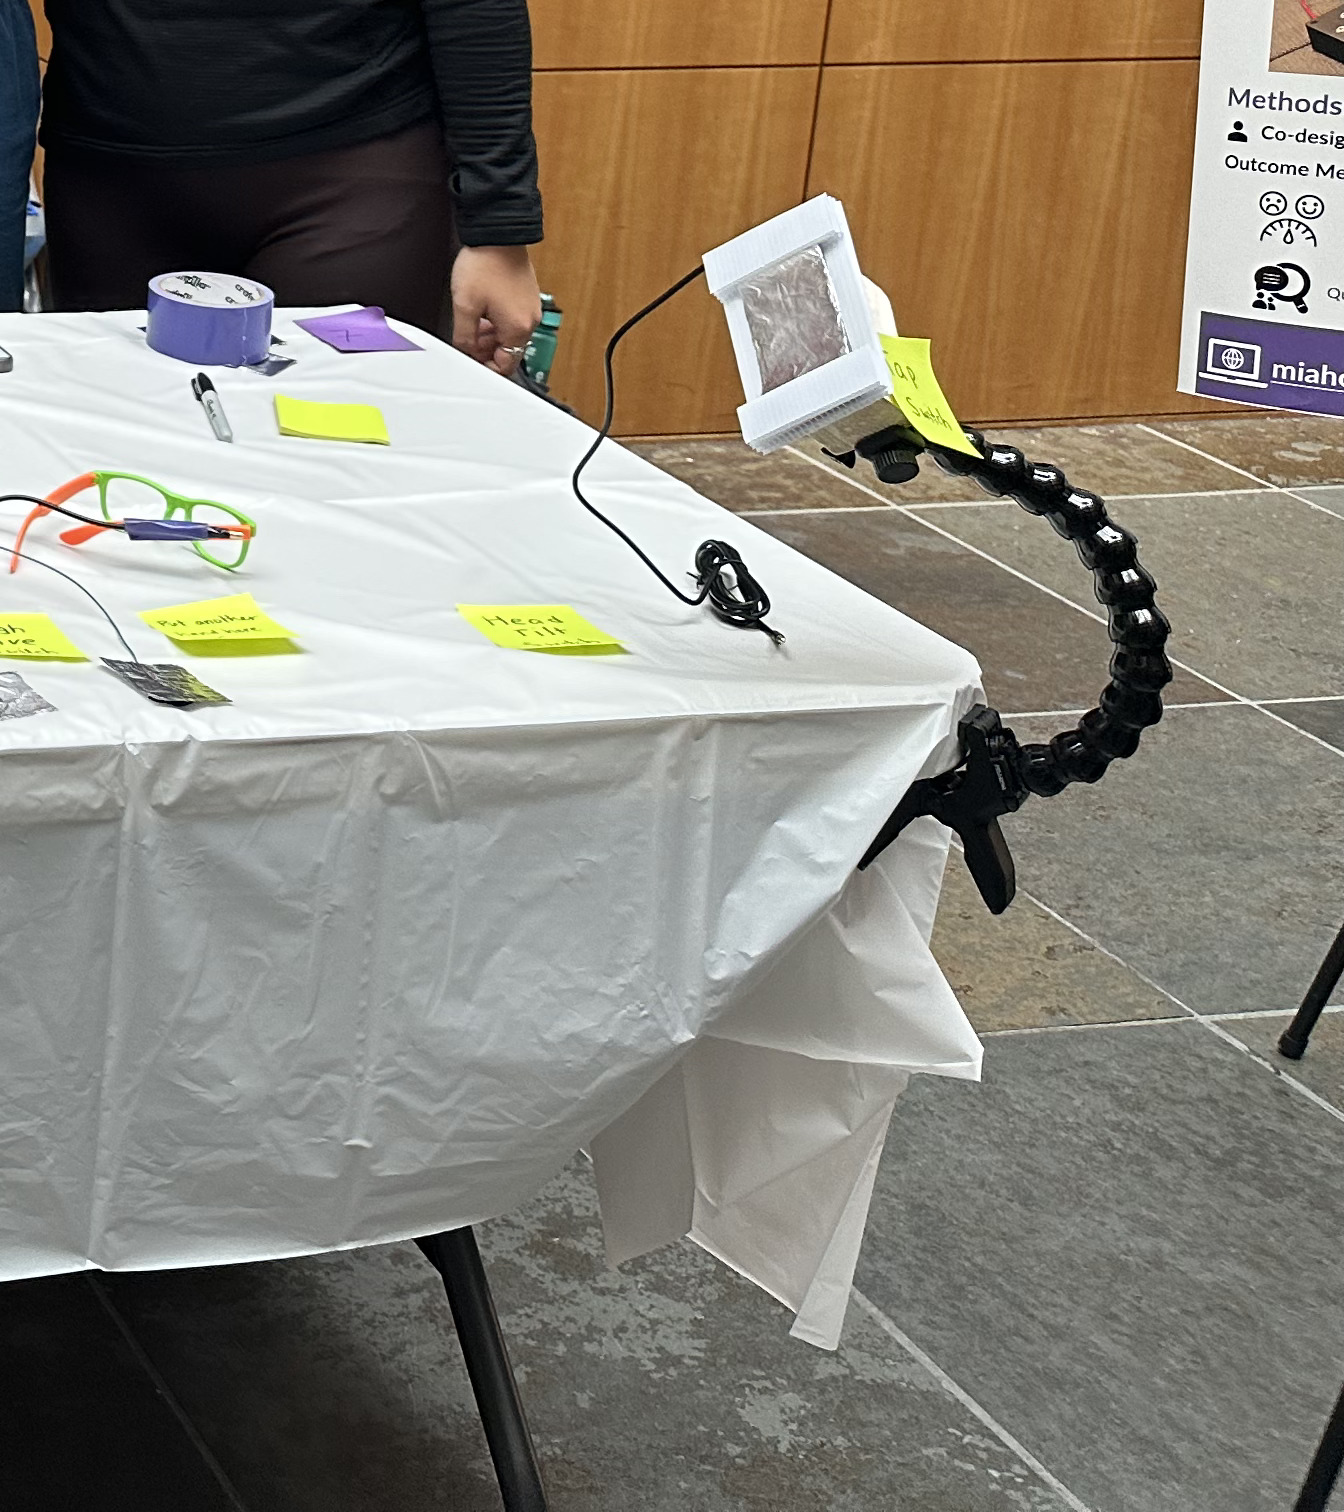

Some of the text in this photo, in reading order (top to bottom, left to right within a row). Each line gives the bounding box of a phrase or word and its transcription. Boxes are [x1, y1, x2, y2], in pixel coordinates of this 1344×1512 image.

[1228, 87, 1342, 115] Methods
[1225, 155, 1309, 176] Outcome
[195, 615, 259, 625] another
[482, 616, 564, 626] Head
